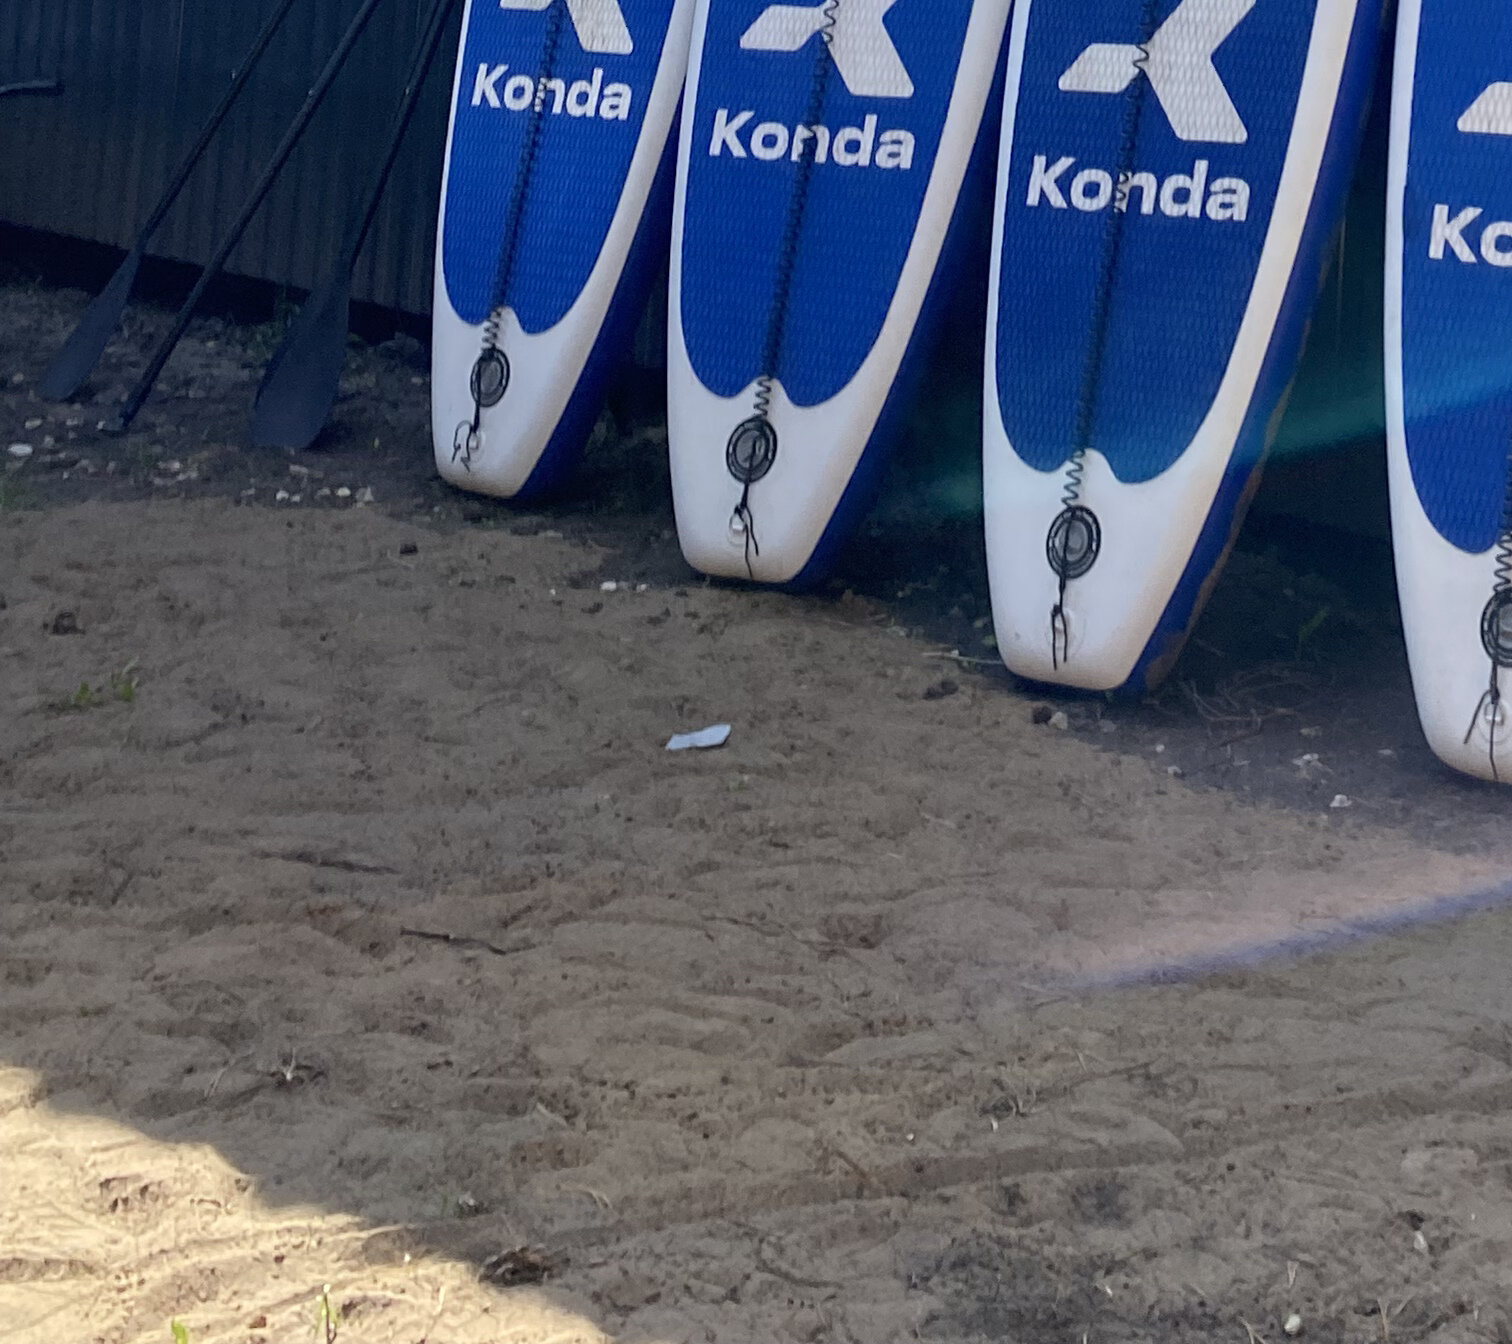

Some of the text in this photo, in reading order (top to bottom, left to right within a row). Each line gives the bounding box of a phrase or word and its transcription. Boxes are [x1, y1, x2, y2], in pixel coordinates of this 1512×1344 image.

[471, 63, 632, 121] Konda
[709, 108, 915, 169] Konda
[1026, 154, 1250, 222] Konda
